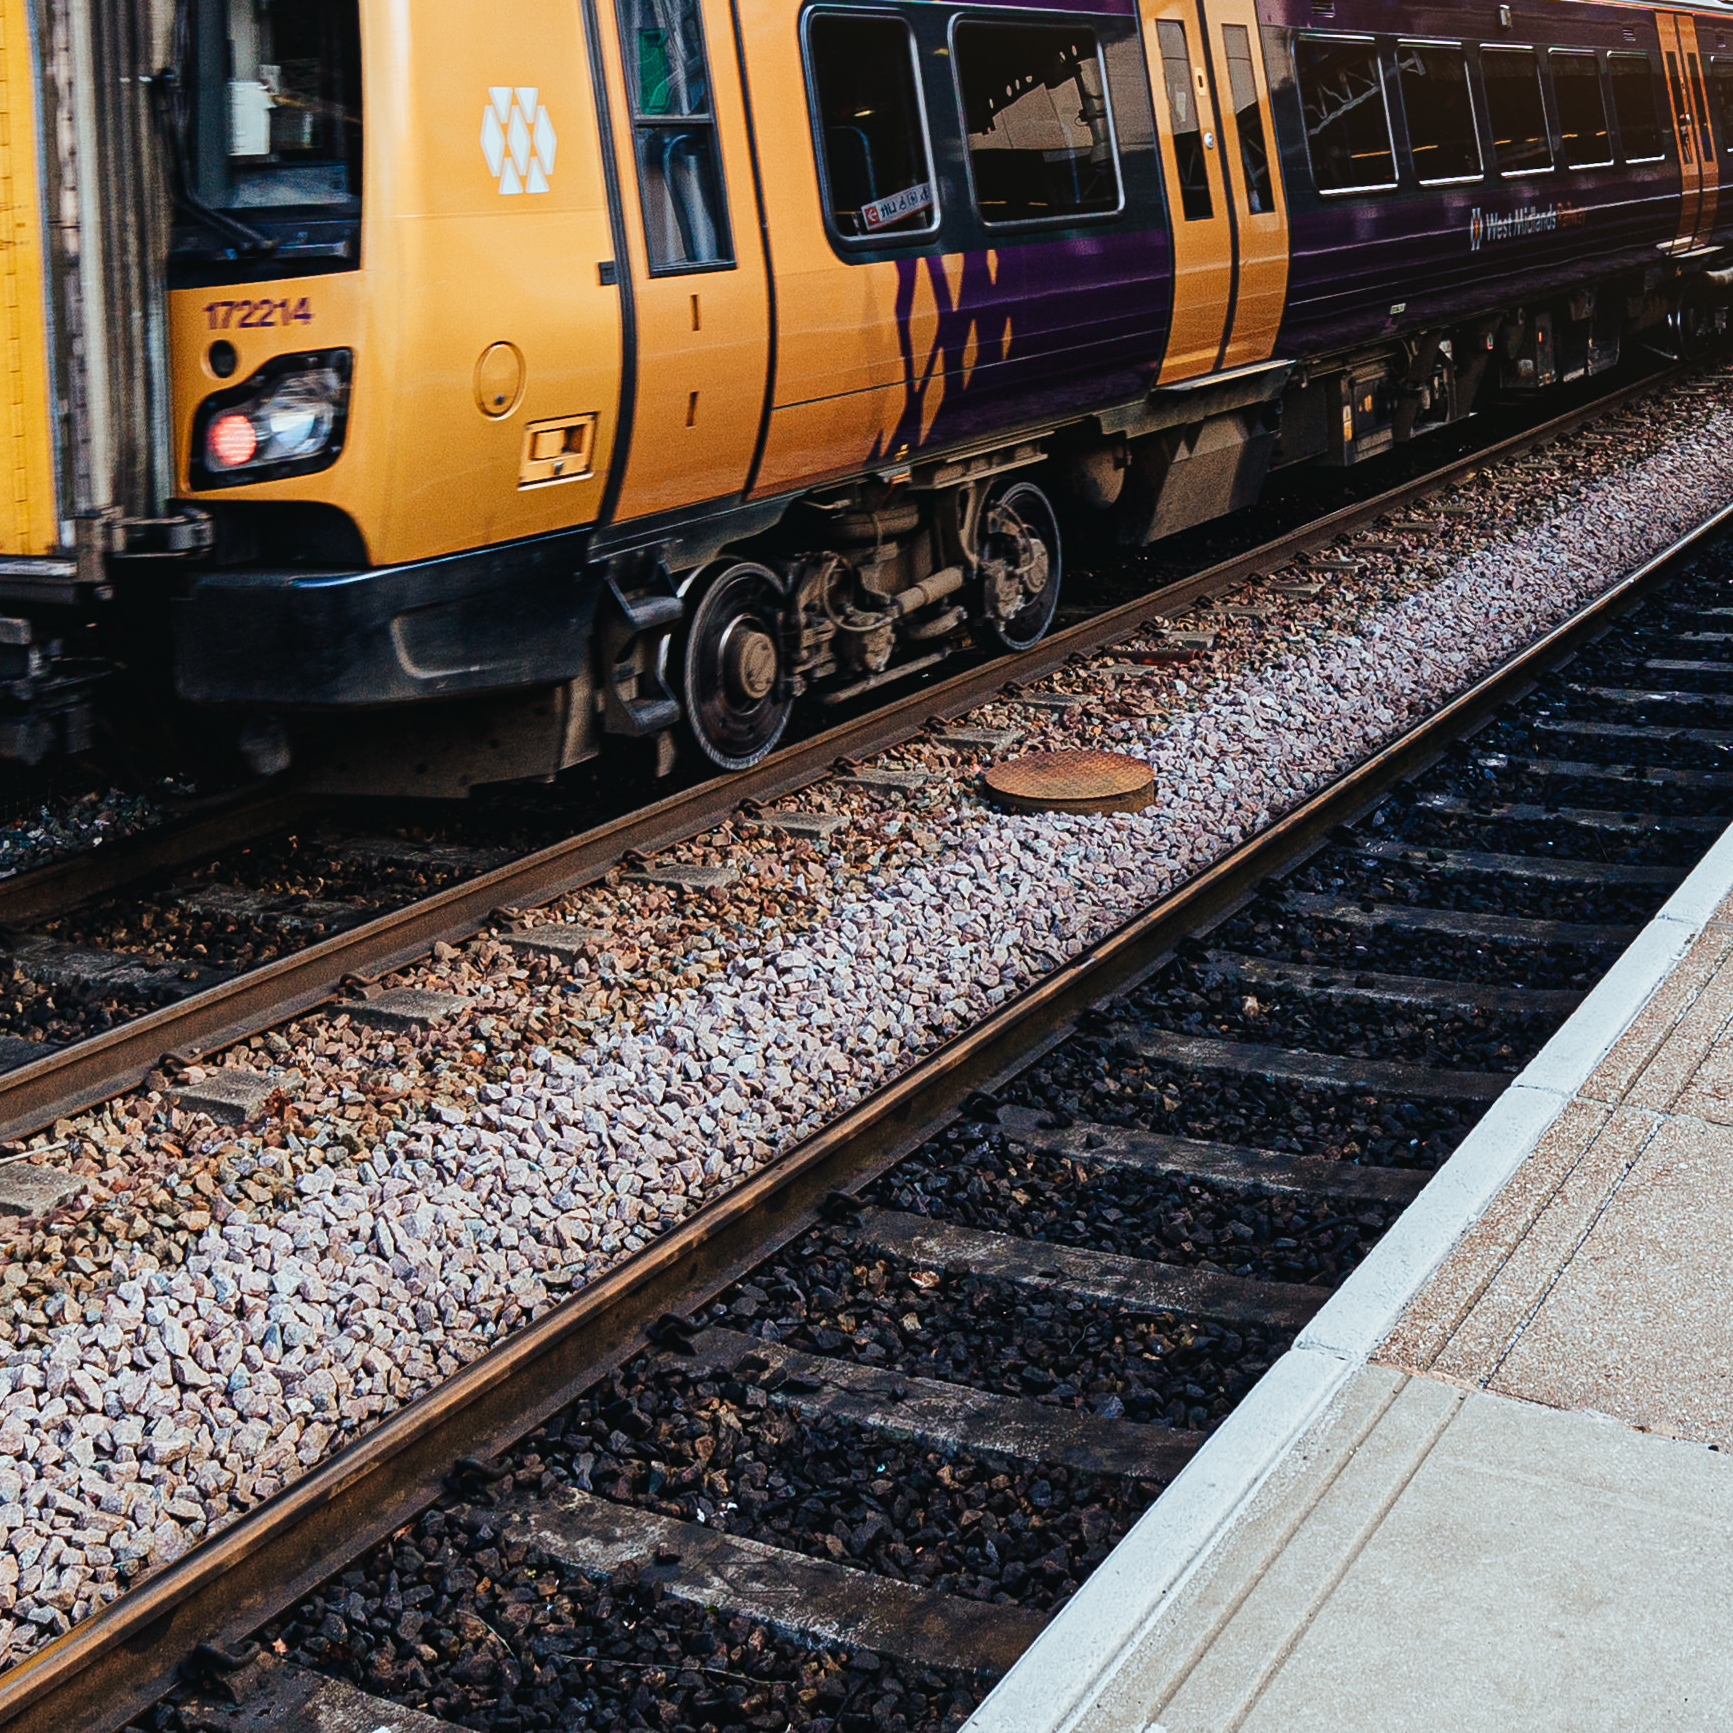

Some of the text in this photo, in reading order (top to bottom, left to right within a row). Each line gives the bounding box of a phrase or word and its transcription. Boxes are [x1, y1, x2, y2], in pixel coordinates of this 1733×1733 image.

[1486, 212, 1512, 241] West
[1514, 203, 1557, 235] Midlands
[203, 296, 313, 330] 172214
